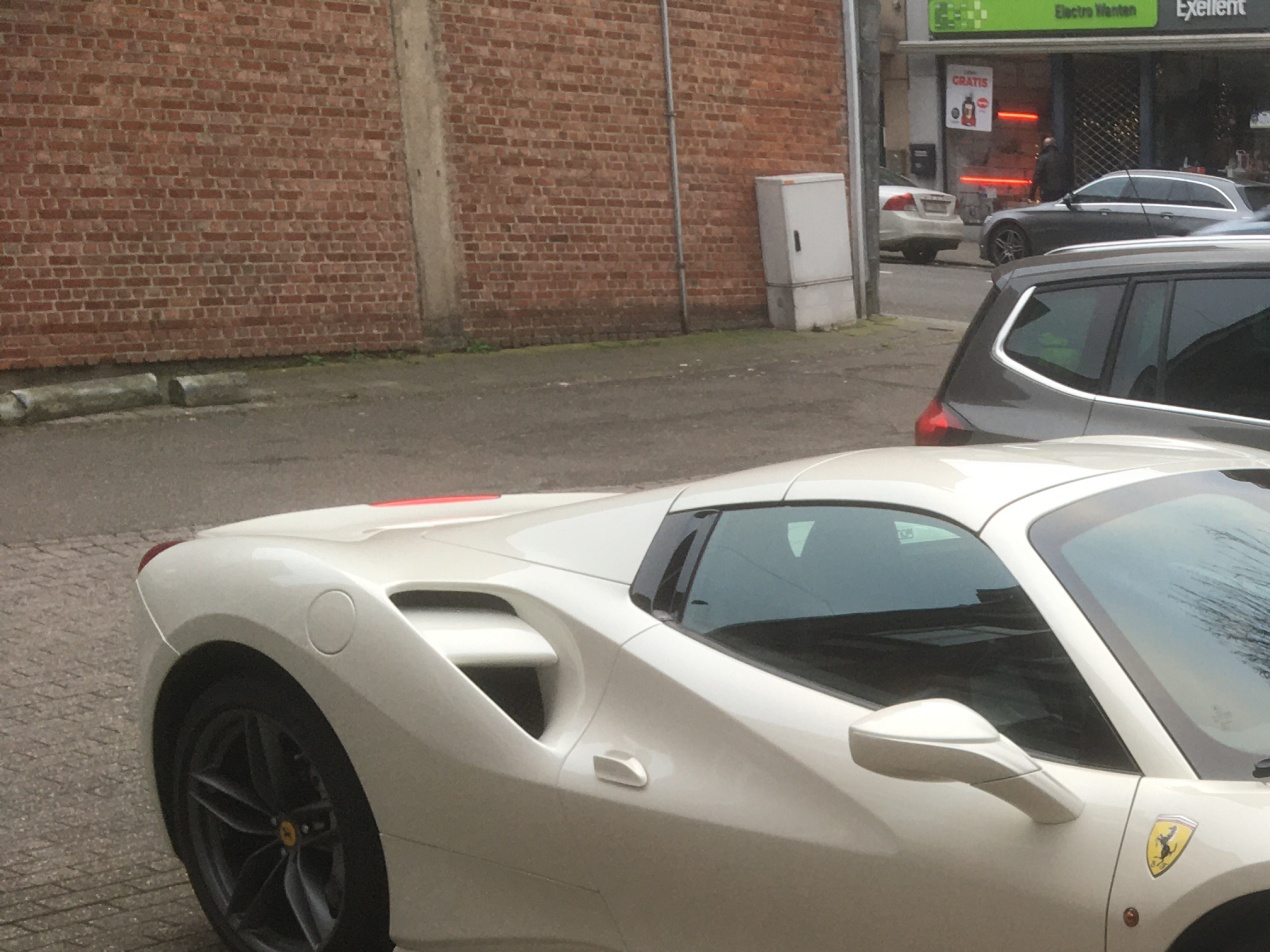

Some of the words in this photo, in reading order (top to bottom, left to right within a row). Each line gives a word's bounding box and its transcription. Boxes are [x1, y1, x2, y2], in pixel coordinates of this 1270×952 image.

[1055, 4, 1093, 19] Electro
[1176, 0, 1247, 21] Exellent
[952, 75, 988, 88] GRATIS
